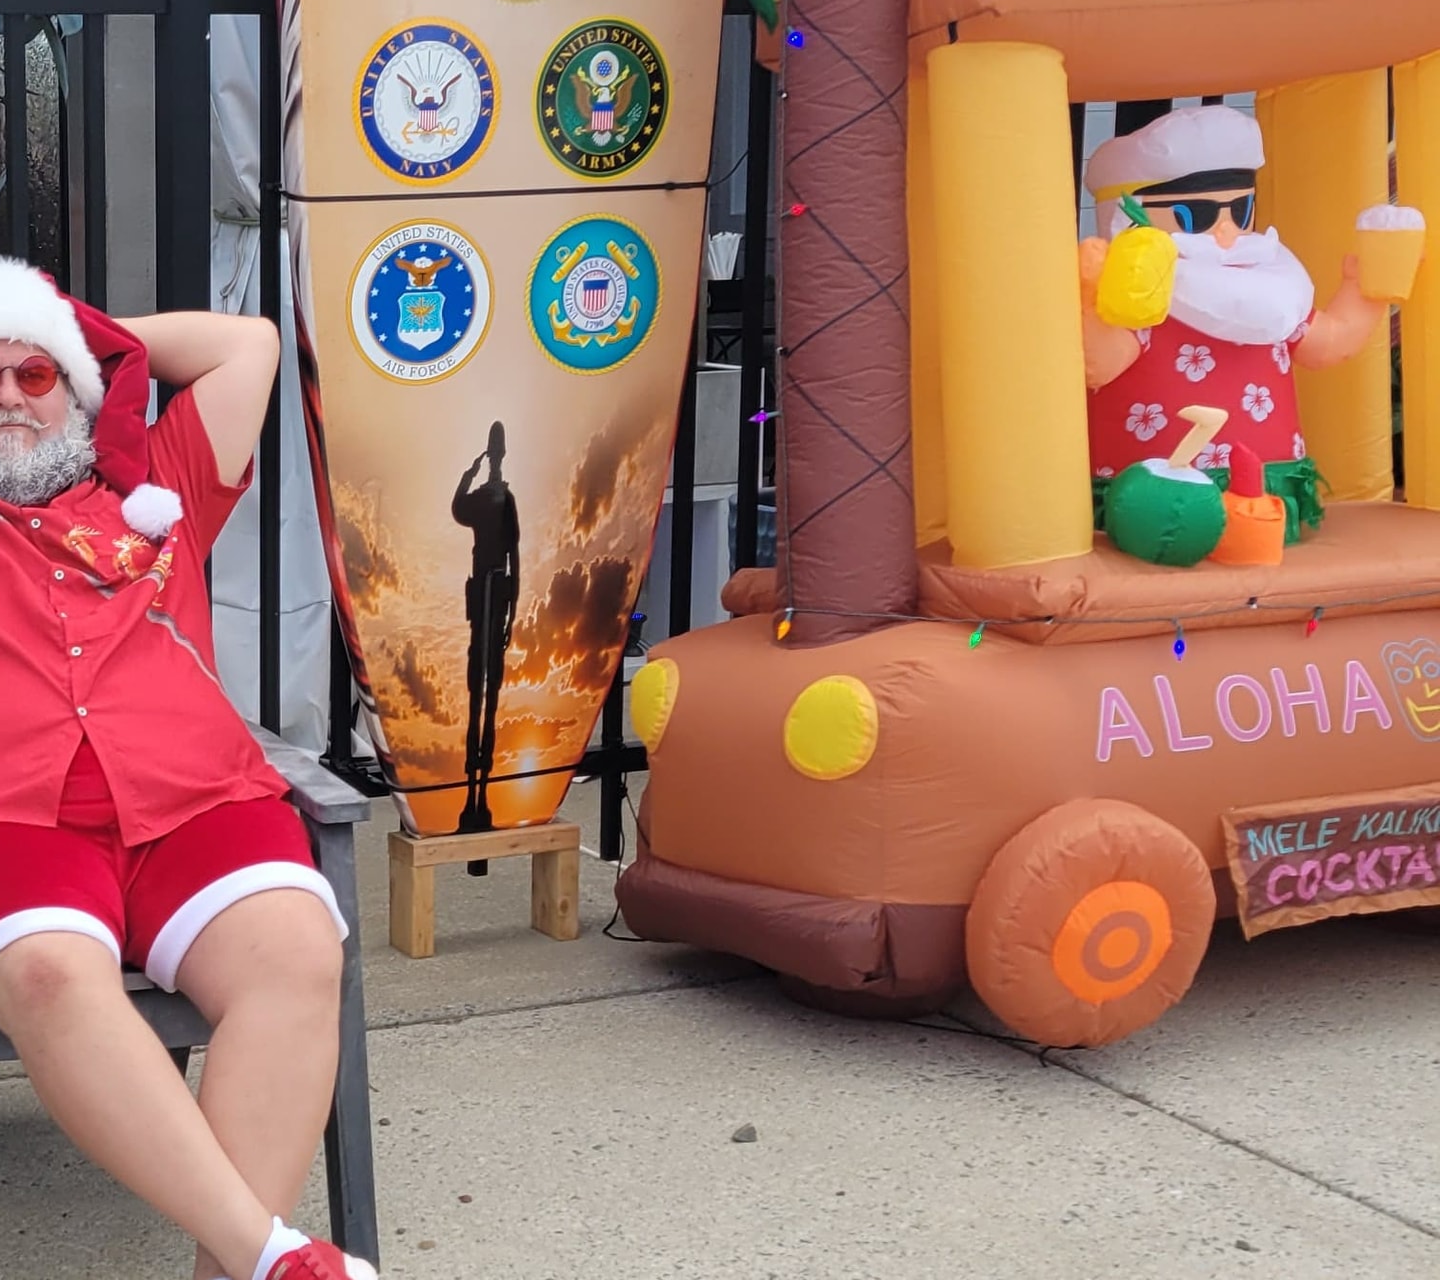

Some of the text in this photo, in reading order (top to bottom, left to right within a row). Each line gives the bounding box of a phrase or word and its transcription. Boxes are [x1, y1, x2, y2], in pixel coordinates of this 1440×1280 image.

[552, 28, 658, 74] UNITED STATES
[362, 31, 493, 117] UNITED STATES
[400, 159, 453, 176] NAVY
[576, 150, 627, 169] ARMY
[372, 226, 474, 261] UNITED STATES
[565, 260, 626, 320] UNITED STATES COAST GUARD
[585, 320, 604, 329] 1790
[382, 355, 456, 377] AIR FORCE
[1096, 661, 1392, 762] ALOHA
[1247, 817, 1341, 861] MELE
